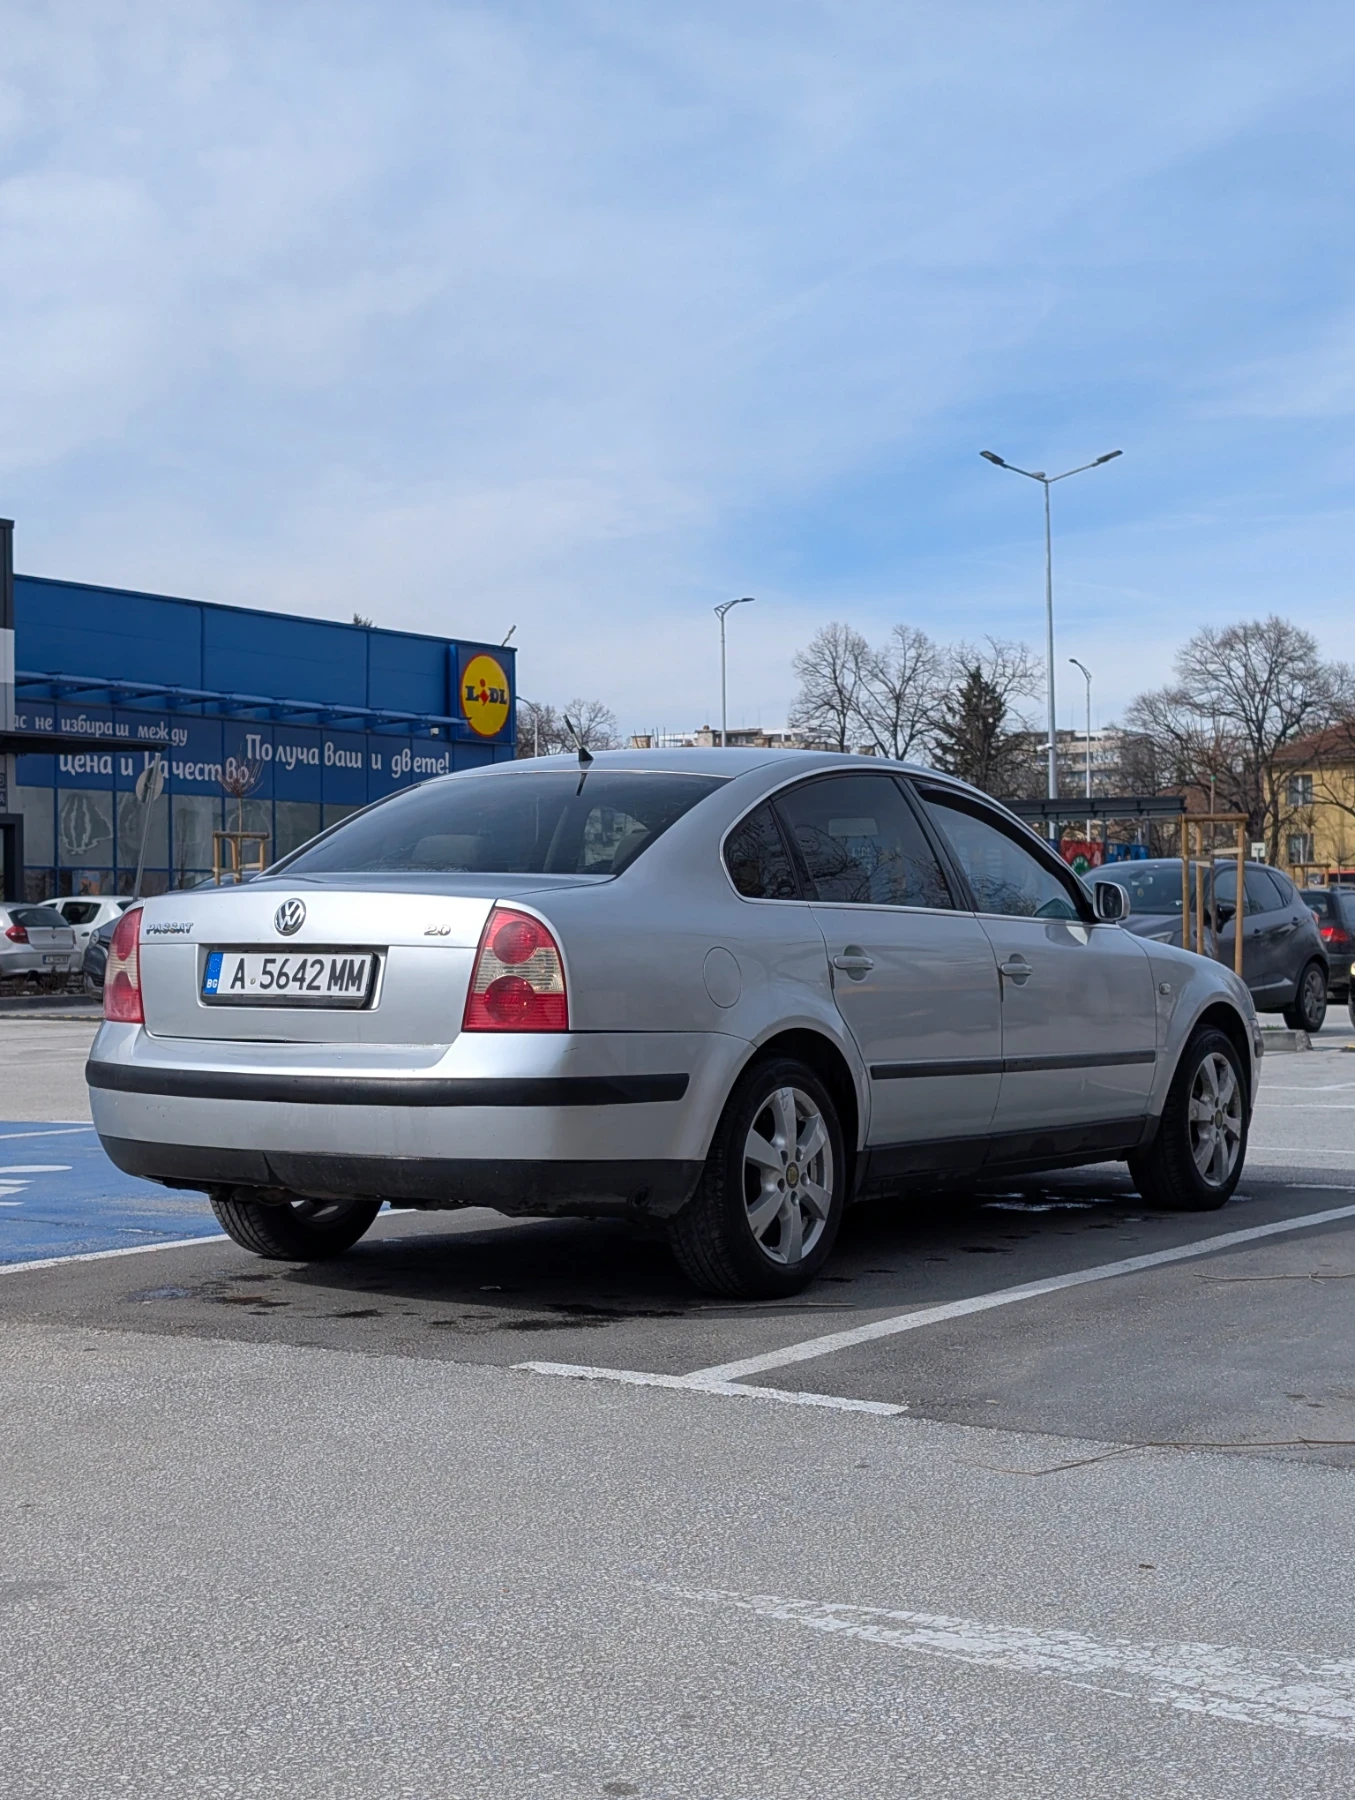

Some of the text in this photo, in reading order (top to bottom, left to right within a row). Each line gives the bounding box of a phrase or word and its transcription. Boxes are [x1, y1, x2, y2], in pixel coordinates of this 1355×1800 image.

[465, 679, 507, 705] LIDL
[35, 717, 53, 731] не
[61, 714, 130, 738] избираш
[137, 721, 188, 746] между
[59, 754, 113, 776] цена
[120, 757, 133, 776] и
[371, 753, 382, 770] и
[391, 748, 450, 779] двете!
[146, 922, 194, 935] PASSAT
[424, 924, 451, 936] 2.0
[206, 979, 218, 989] BG
